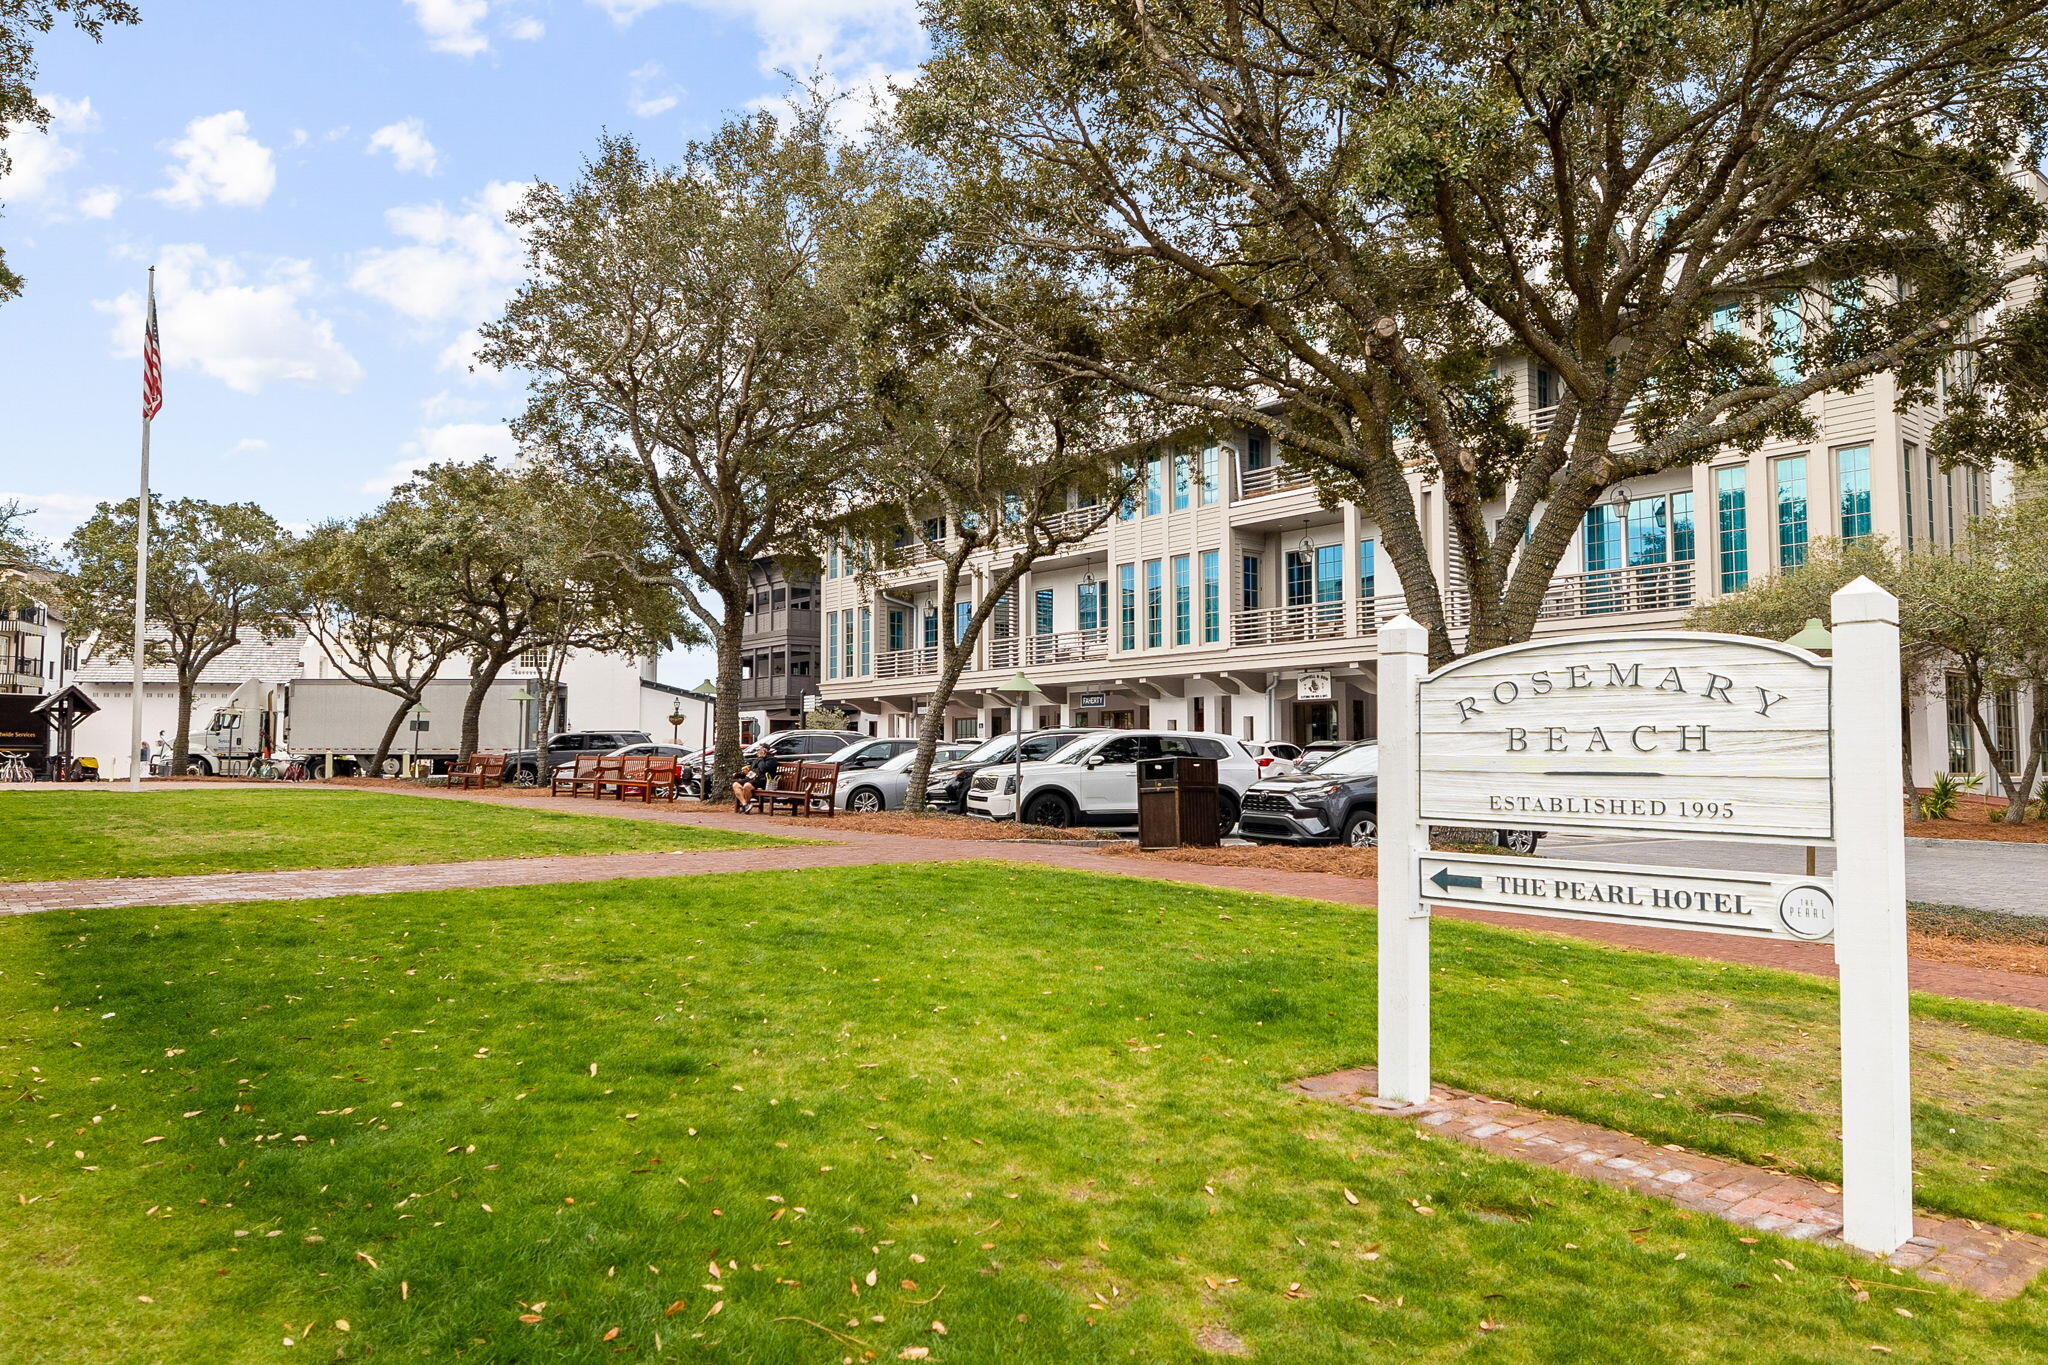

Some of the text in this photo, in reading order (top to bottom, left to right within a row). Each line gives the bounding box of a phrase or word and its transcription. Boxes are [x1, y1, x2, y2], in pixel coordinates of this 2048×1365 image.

[1455, 662, 1788, 724] ROSEMARY
[1505, 725, 1711, 752] BEACH
[1489, 795, 1734, 819] ESTABLISHED 1995
[1496, 876, 1752, 915] THE PEARL HOTEL
[1800, 898, 1814, 907] THE
[1789, 906, 1826, 920] PEARL
